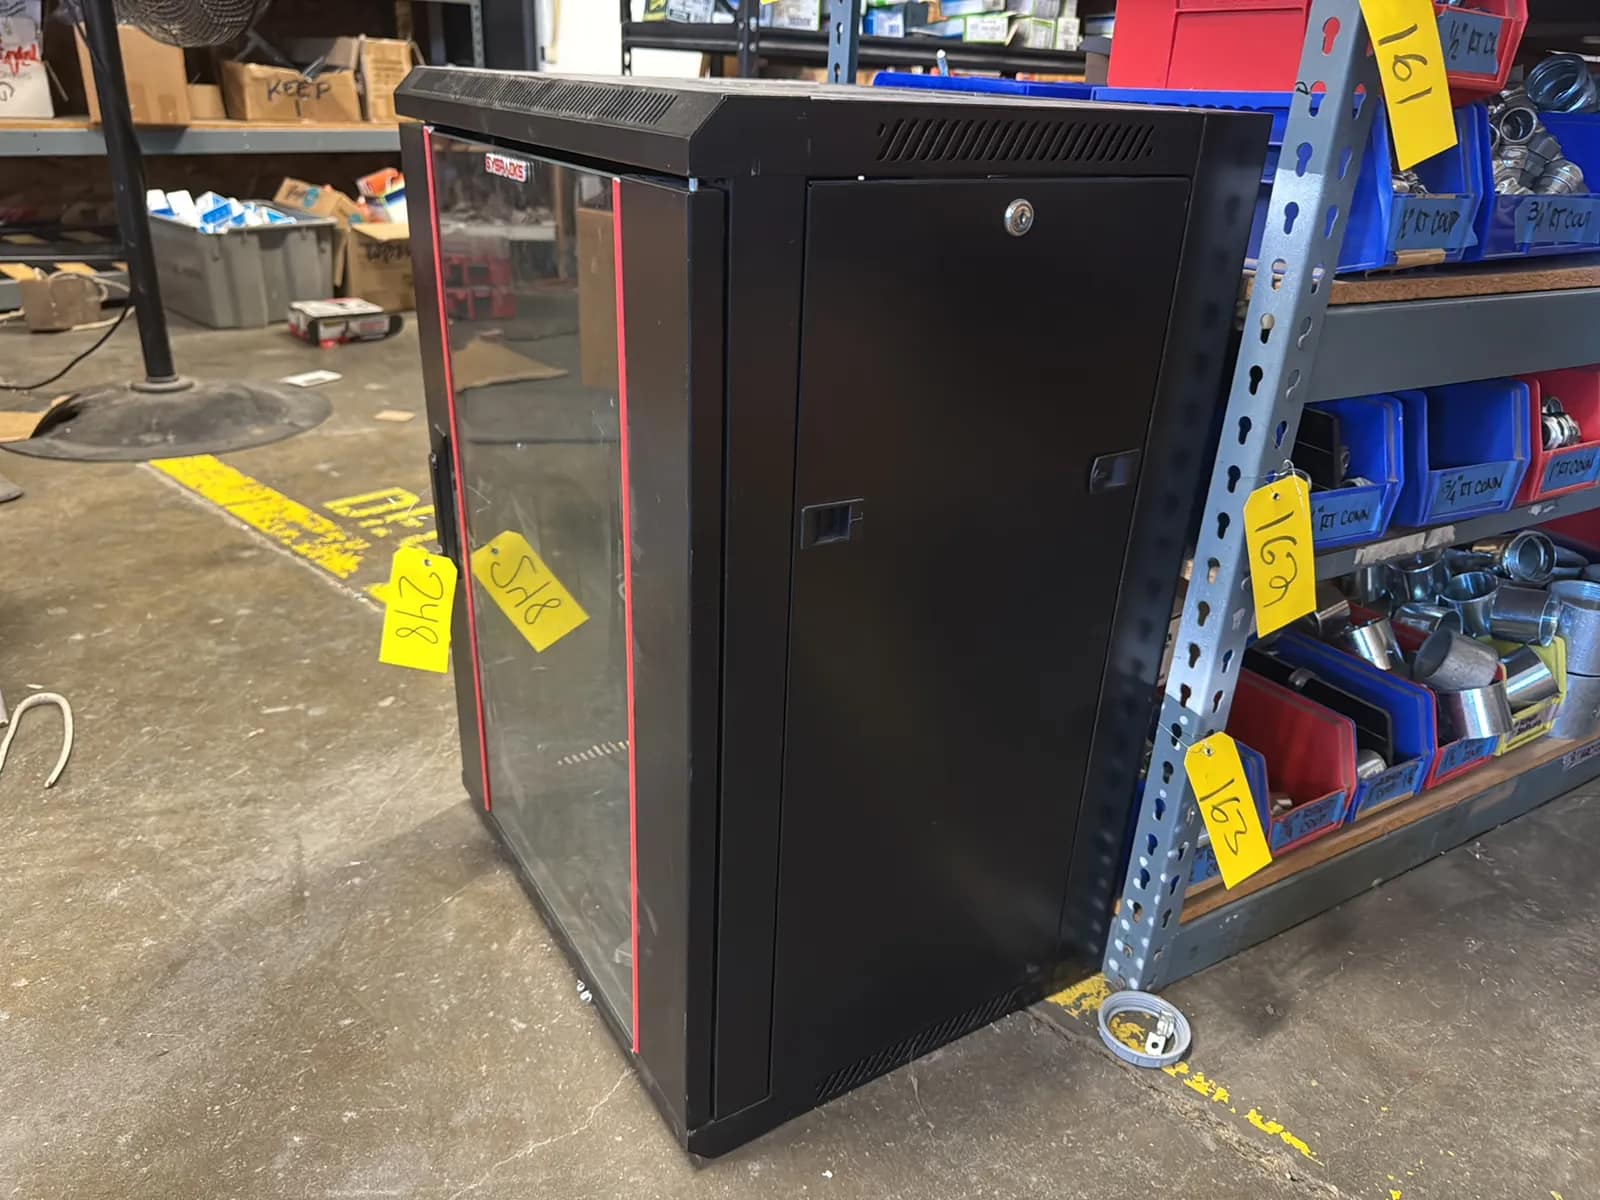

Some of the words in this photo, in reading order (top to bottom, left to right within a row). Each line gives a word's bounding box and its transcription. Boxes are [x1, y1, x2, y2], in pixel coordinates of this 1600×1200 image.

[266, 80, 332, 101] KEEP
[1377, 24, 1434, 105] 161
[1254, 511, 1298, 609] 162
[395, 572, 445, 646] 248
[1199, 778, 1248, 857] 163
